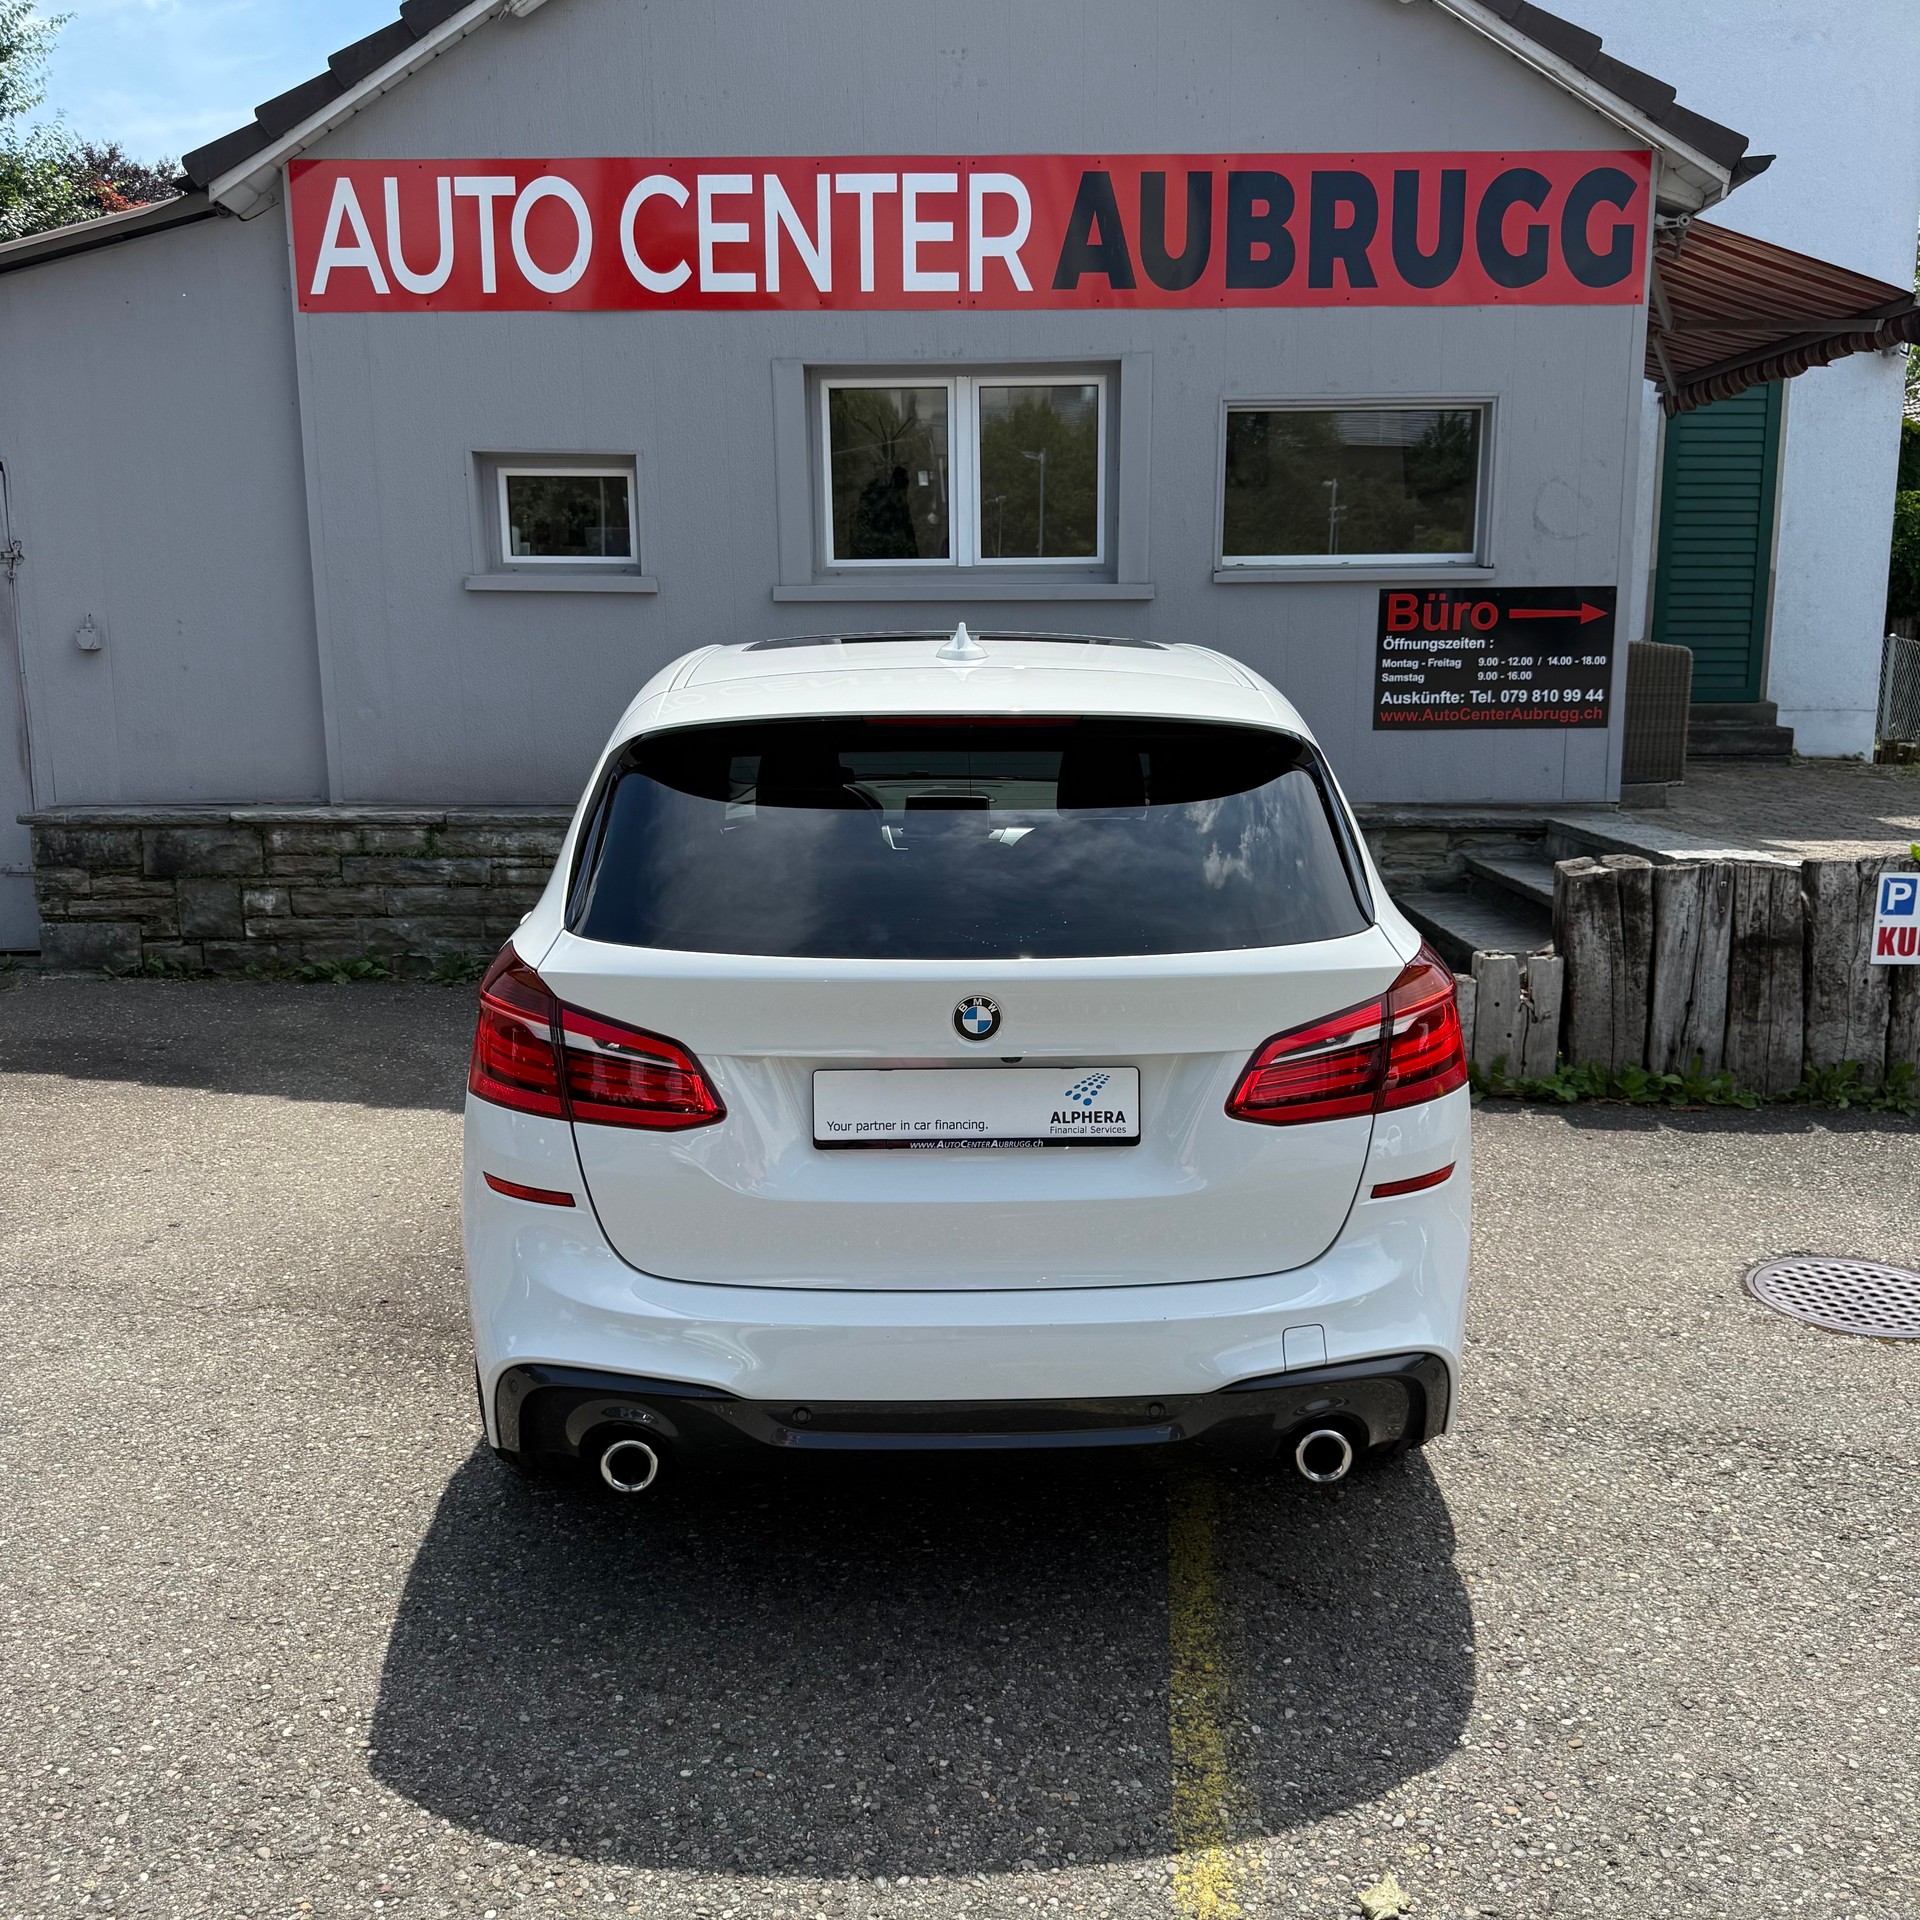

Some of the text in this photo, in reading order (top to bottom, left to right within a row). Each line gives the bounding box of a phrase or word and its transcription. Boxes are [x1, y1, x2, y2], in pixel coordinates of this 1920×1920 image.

[310, 167, 1639, 295] AUTO CENTER AUBRUGG
[1387, 593, 1499, 631] Büro
[1383, 636, 1485, 652] Öffnungszeiten
[1382, 658, 1419, 669] Montag
[1427, 658, 1462, 668] Freitag
[1478, 657, 1499, 667] 9.00
[1508, 657, 1533, 666] 12.00
[1548, 656, 1572, 666] 14.00
[1581, 656, 1607, 665] 18.00
[1381, 673, 1425, 683] Samstag
[1477, 672, 1498, 681] 9.00
[1507, 671, 1533, 680] 16.00
[1380, 689, 1604, 705] Auskünfte: Tel. 079 810 99 44
[1380, 706, 1602, 722] www.AutoCenterAubrugg.ch
[1887, 882, 1912, 910] P
[1877, 926, 1920, 957] KU
[958, 998, 998, 1013] BMW
[827, 1121, 852, 1131] Your
[856, 1120, 896, 1132] partner
[900, 1120, 910, 1130] in
[935, 1119, 989, 1131] financing.
[1050, 1111, 1126, 1124] ALPHERA
[1050, 1126, 1126, 1134] Financial Services
